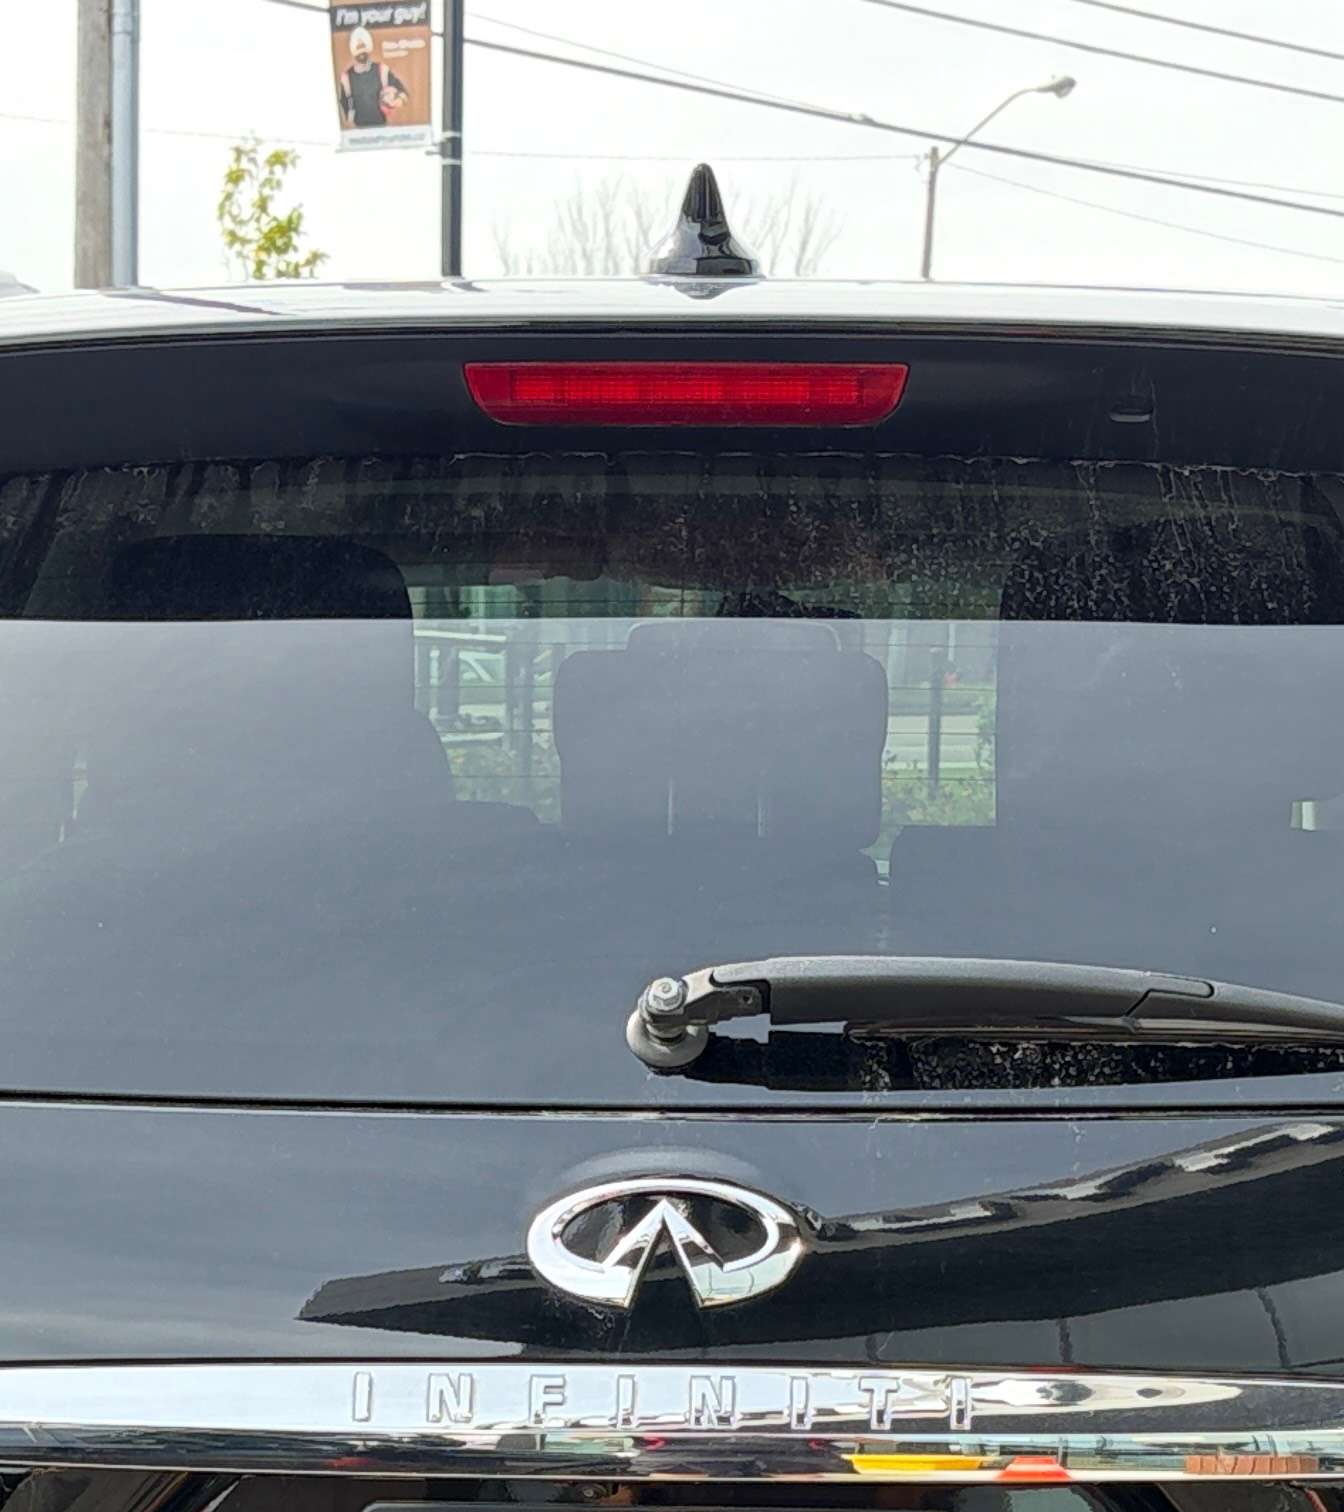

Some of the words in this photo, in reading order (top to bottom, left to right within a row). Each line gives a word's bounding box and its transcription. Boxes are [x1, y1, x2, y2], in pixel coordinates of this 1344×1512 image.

[336, 8, 359, 26] I'm
[360, 6, 394, 27] your
[394, 1, 427, 25] guy!
[352, 1371, 973, 1431] INFINITI
